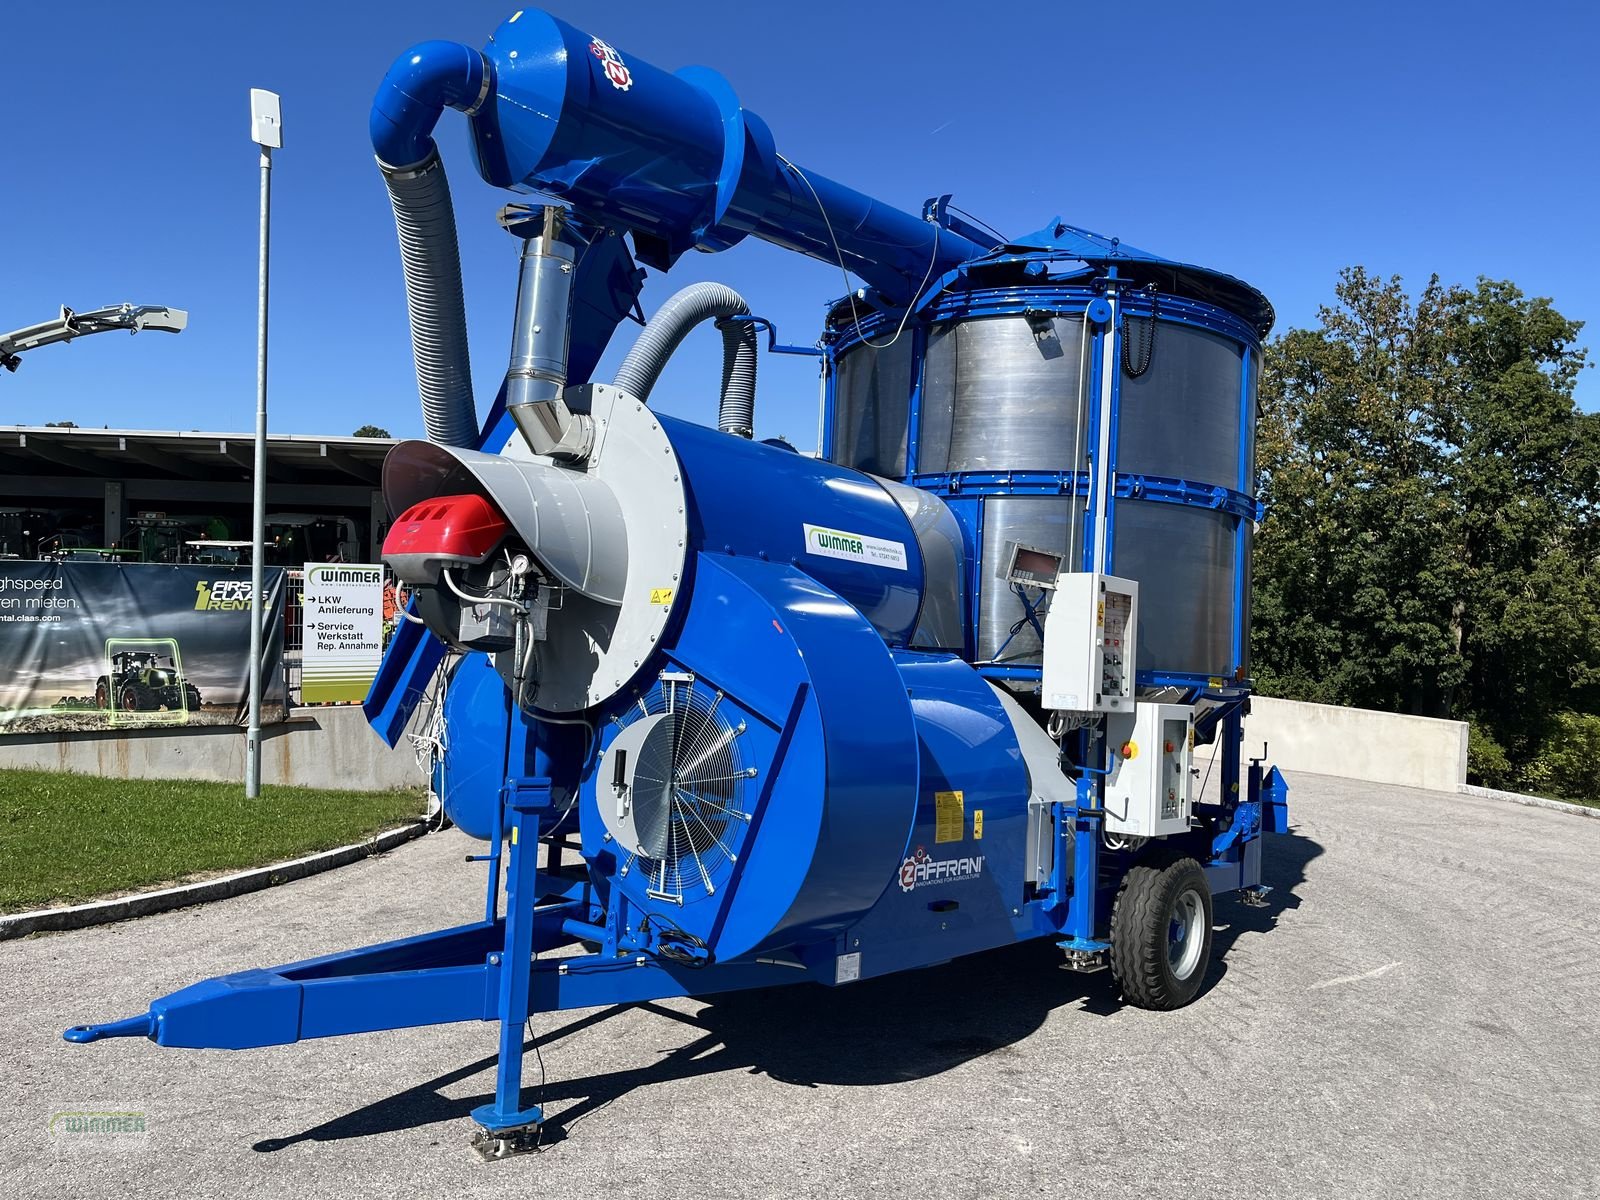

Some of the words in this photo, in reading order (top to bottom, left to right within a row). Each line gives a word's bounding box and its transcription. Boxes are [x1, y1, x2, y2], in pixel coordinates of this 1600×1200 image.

[817, 533, 864, 554] WIMMER
[321, 570, 380, 583] WIMMER
[212, 580, 253, 591] FIRS
[0, 598, 20, 609] en
[25, 595, 80, 609] mieten.
[207, 600, 272, 610] RENTL
[318, 596, 341, 604] LKW
[318, 605, 374, 616] Anlieferung
[317, 622, 354, 631] Service
[317, 632, 363, 640] Werkstatt
[317, 641, 336, 651] Rep.
[338, 641, 379, 650] Annahme
[903, 856, 982, 884] ZAFFRANI
